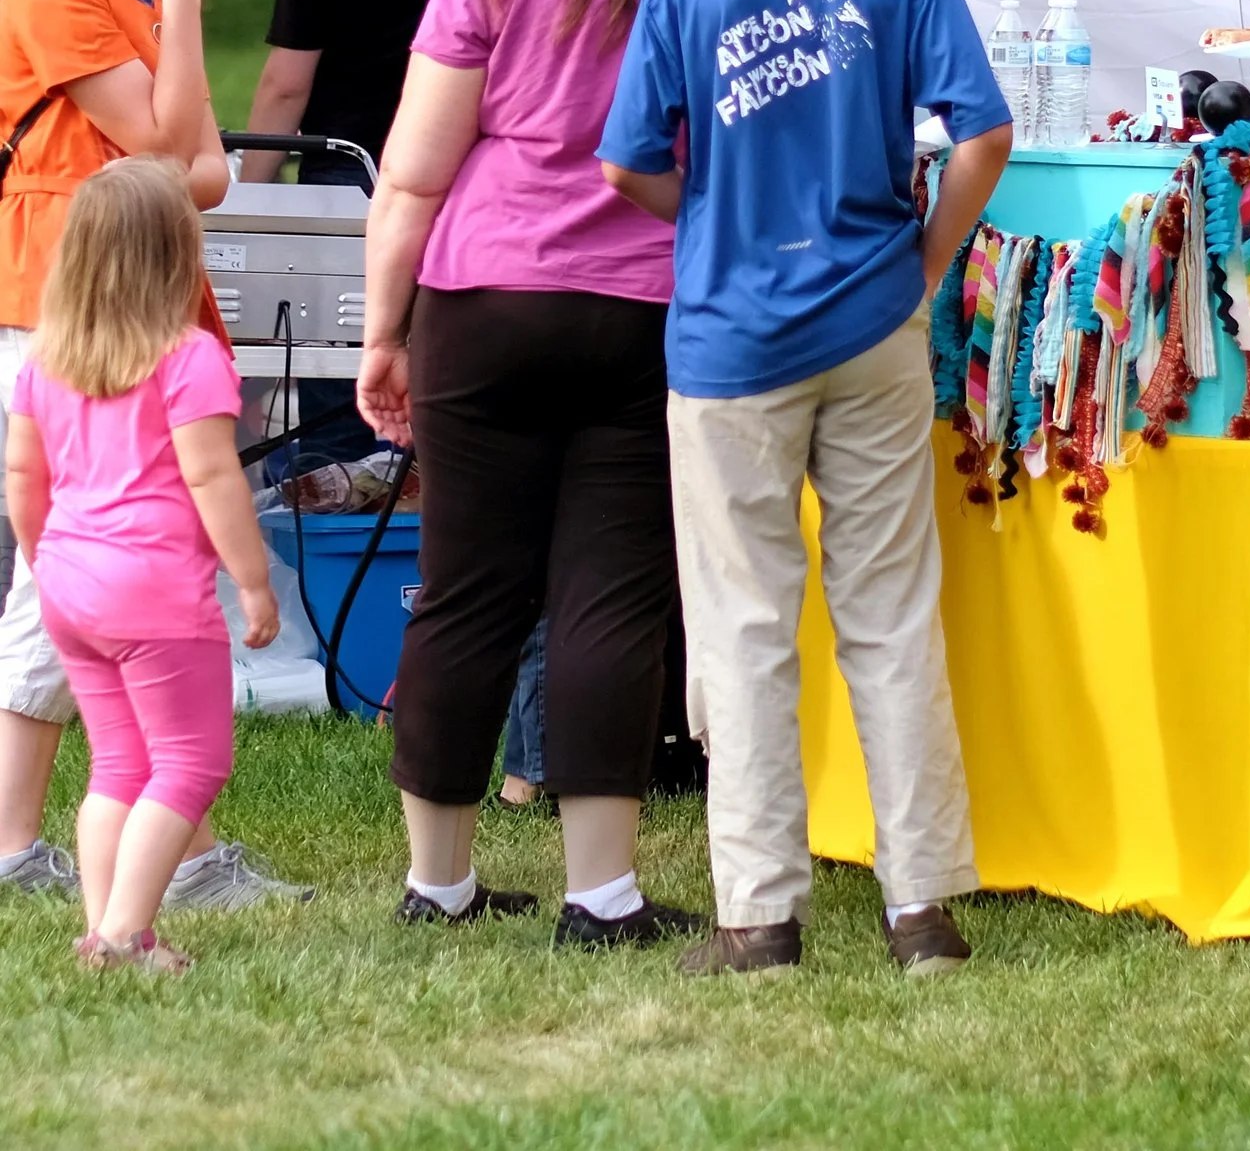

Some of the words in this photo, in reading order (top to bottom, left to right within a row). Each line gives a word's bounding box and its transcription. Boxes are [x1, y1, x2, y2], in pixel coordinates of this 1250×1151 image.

[716, 5, 815, 76] ALCON
[721, 16, 756, 45] ONCE
[763, 9, 775, 26] A
[715, 49, 831, 127] FALCON
[731, 54, 789, 96] ALWAYS
[793, 48, 807, 66] A
